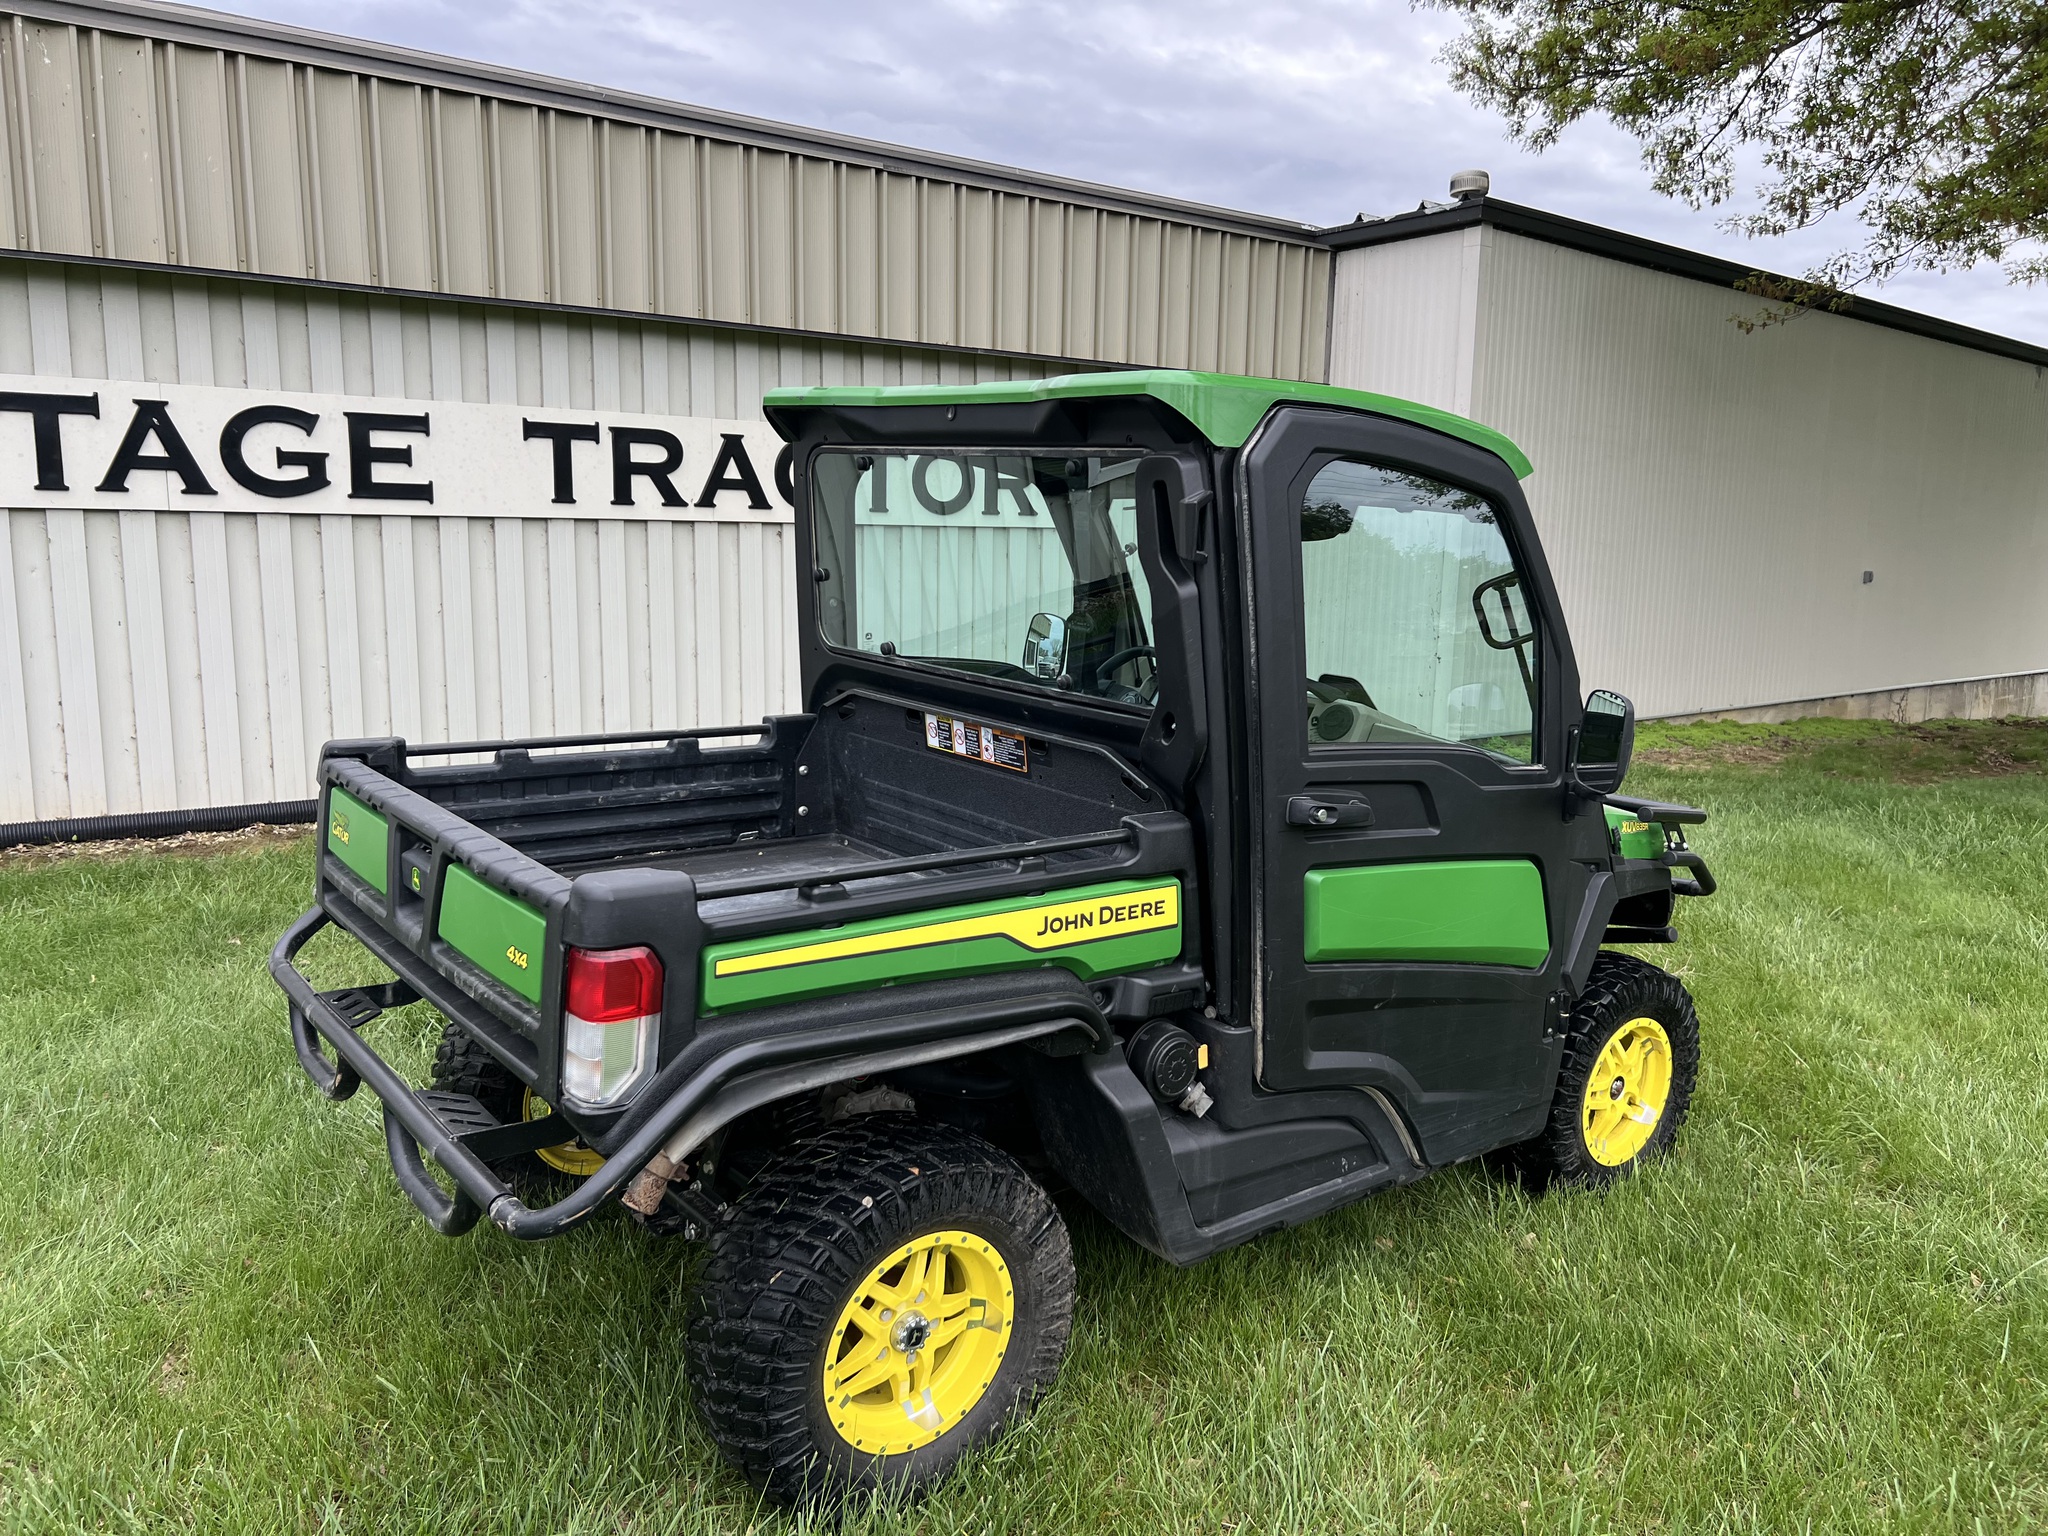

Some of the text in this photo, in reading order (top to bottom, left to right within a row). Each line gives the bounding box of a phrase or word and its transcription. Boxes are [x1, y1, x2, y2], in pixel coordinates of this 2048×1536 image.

[0, 391, 434, 504] TAGE
[1037, 899, 1166, 936] JOHN DEERE
